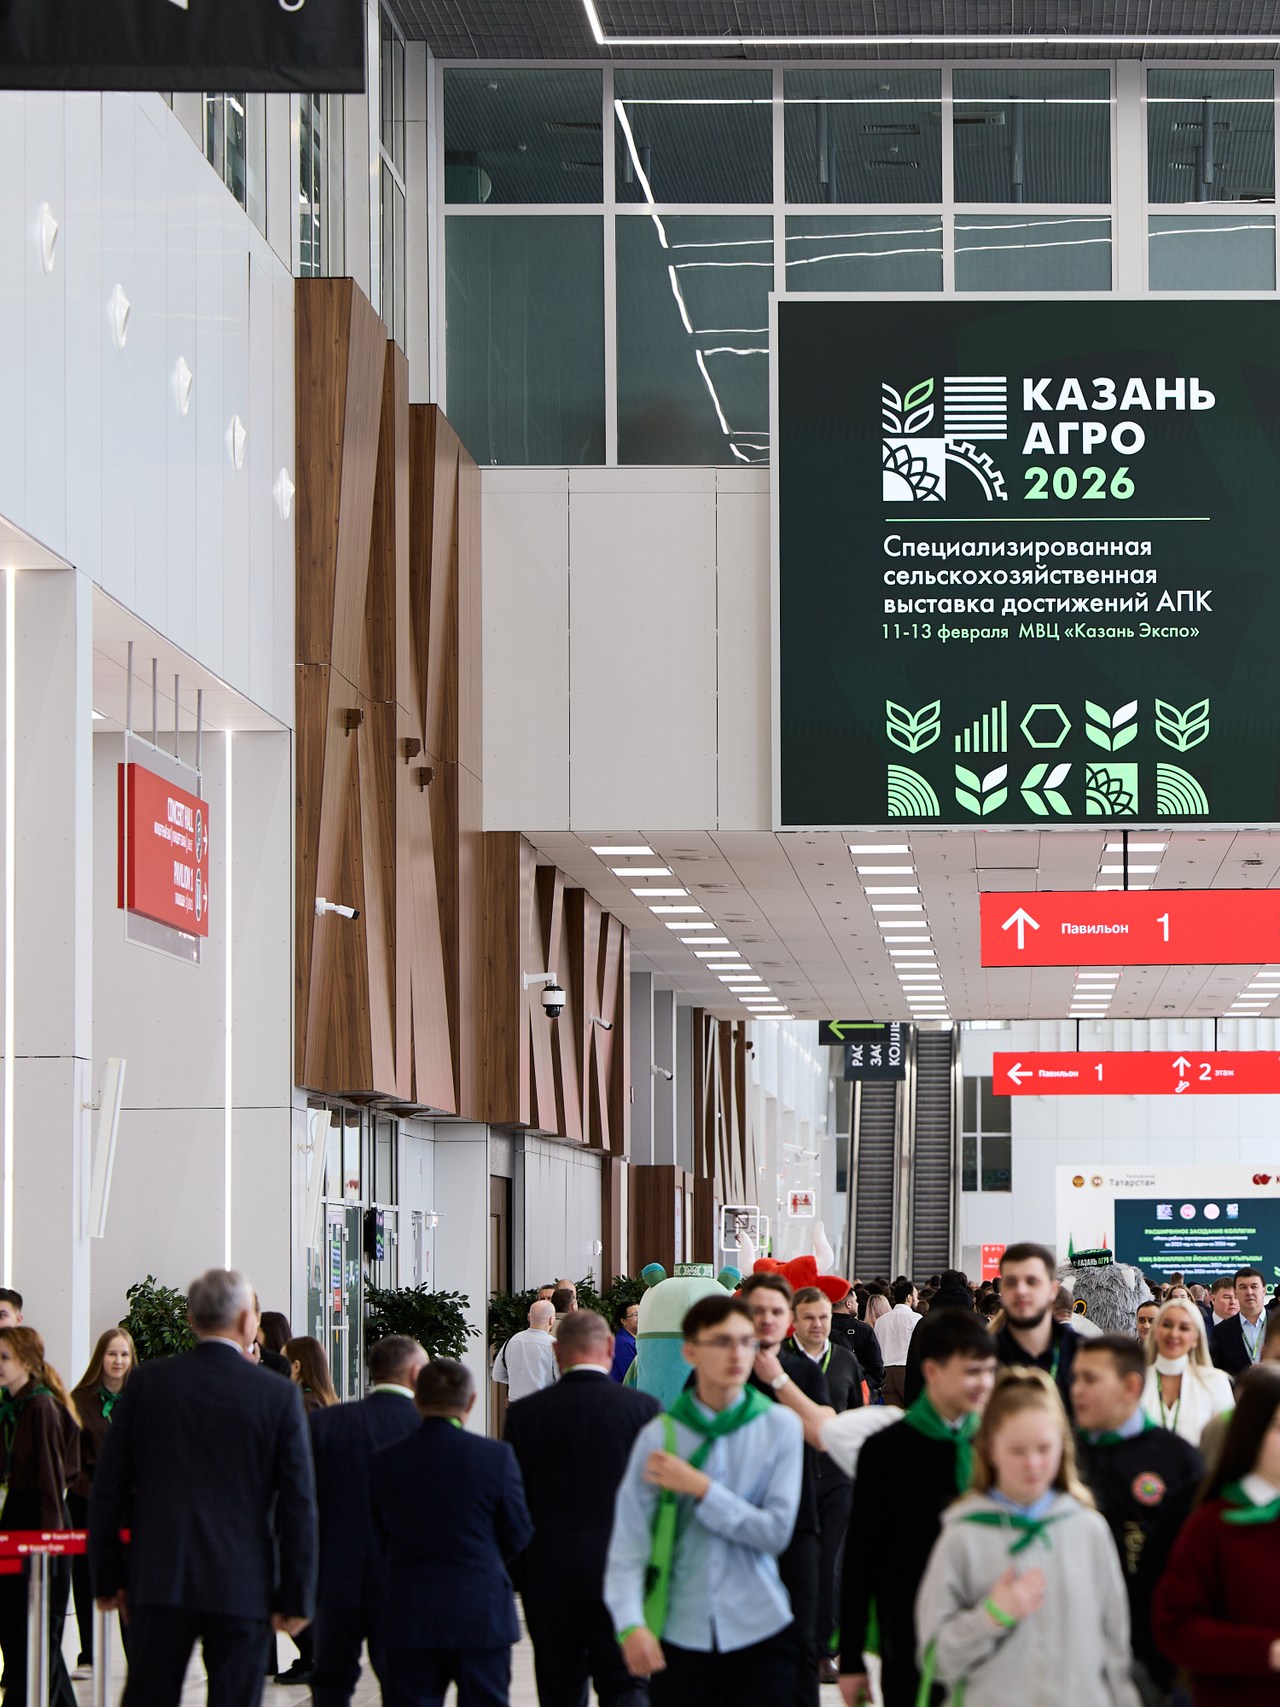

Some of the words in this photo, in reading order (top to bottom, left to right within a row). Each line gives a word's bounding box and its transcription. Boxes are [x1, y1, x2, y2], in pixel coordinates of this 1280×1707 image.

[1023, 378, 1215, 410] КАЗАНЬ
[1022, 421, 1145, 454] АГРО
[1024, 467, 1134, 499] 2026
[884, 535, 1151, 562] Специализированная
[884, 564, 1156, 585] сельскохозяйственная
[885, 598, 994, 613] выставка
[1002, 592, 1148, 616] достижений
[1156, 590, 1212, 611] АПК
[883, 624, 931, 638] 11-13
[938, 624, 1008, 643] февраля
[1019, 623, 1059, 640] МВЦ
[1065, 623, 1134, 638] «Казань
[1140, 623, 1199, 637] Экспо»
[1062, 923, 1128, 934] Павильон
[1157, 913, 1169, 941] 1
[1095, 1064, 1102, 1081] 1
[1199, 1063, 1211, 1080] 2
[1110, 1179, 1155, 1187] Татарстан
